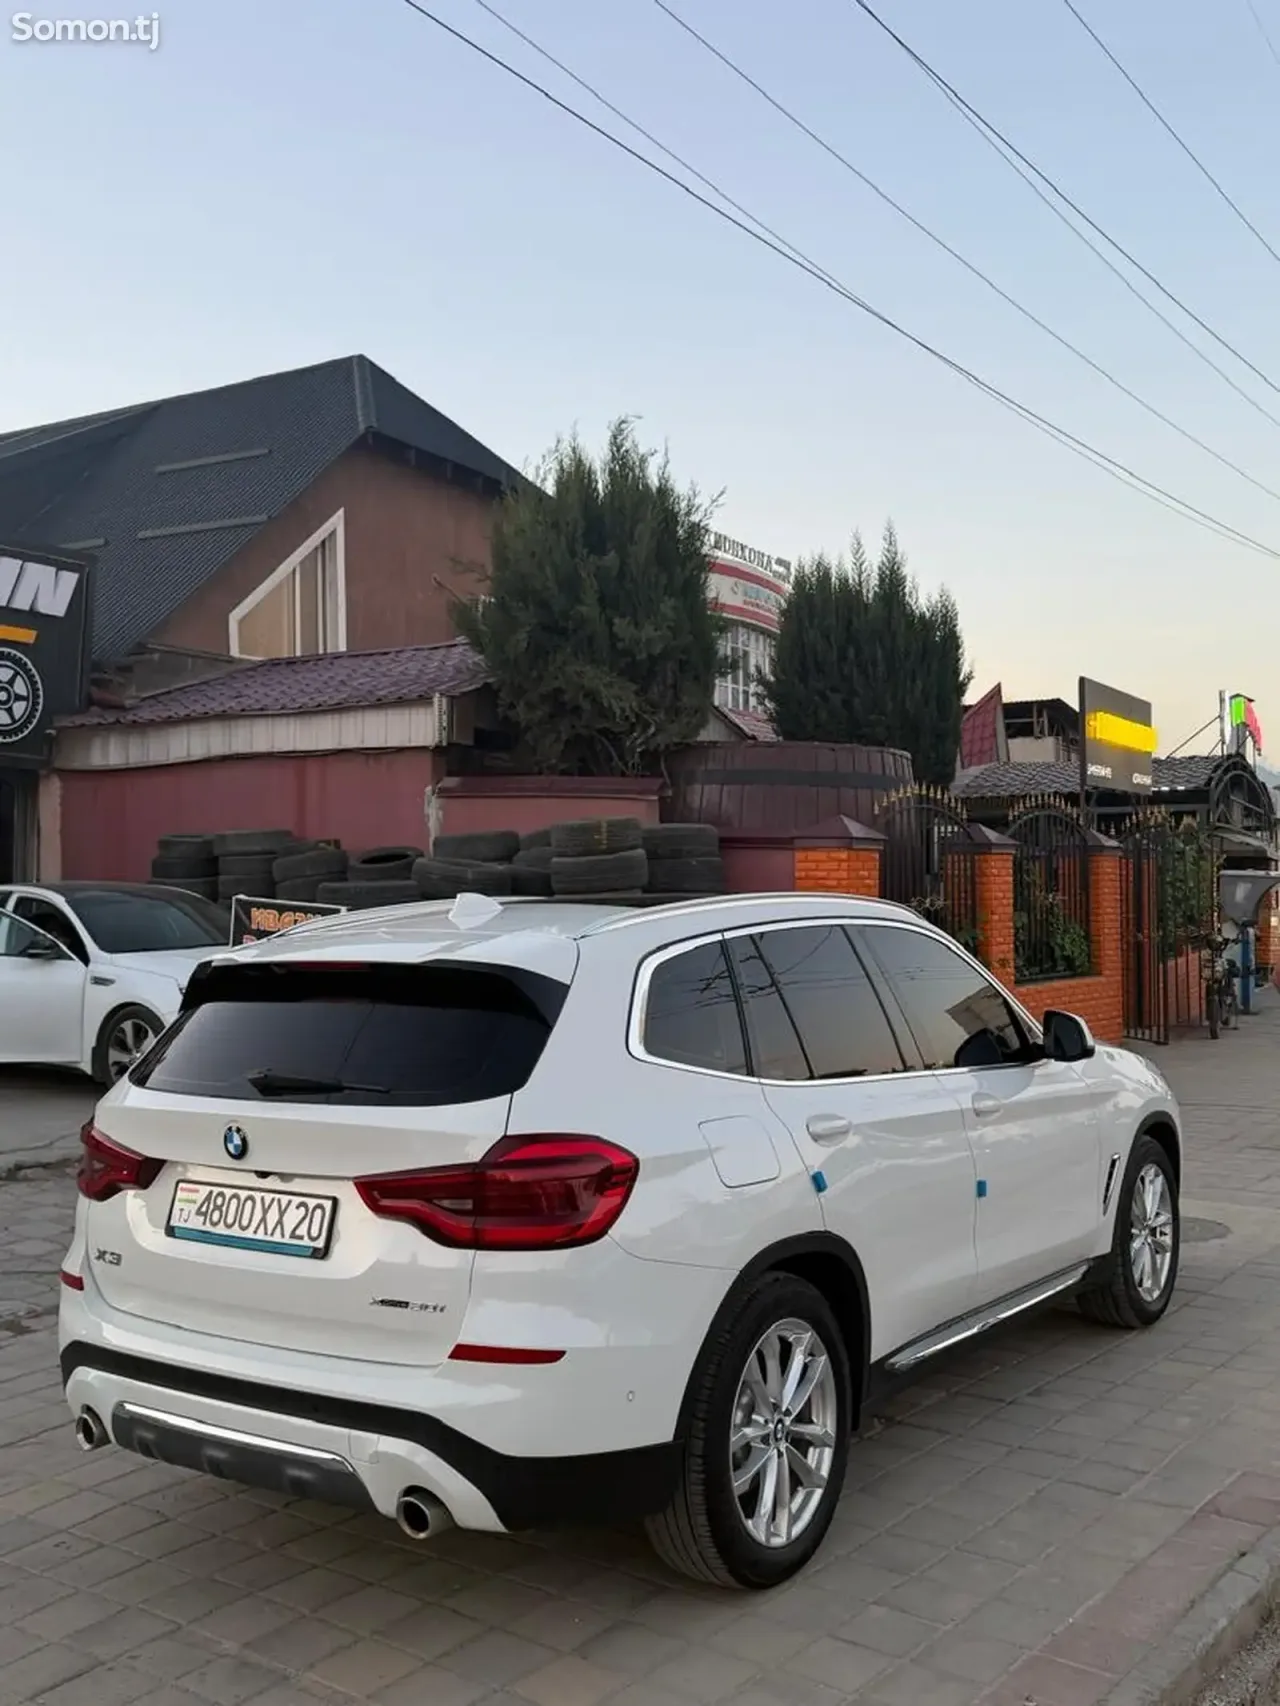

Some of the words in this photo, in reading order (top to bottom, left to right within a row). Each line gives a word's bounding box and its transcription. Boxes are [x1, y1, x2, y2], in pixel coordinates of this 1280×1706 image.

[177, 1207, 191, 1223] TJ
[195, 1189, 327, 1242] 4800XX20
[94, 1247, 122, 1266] X3
